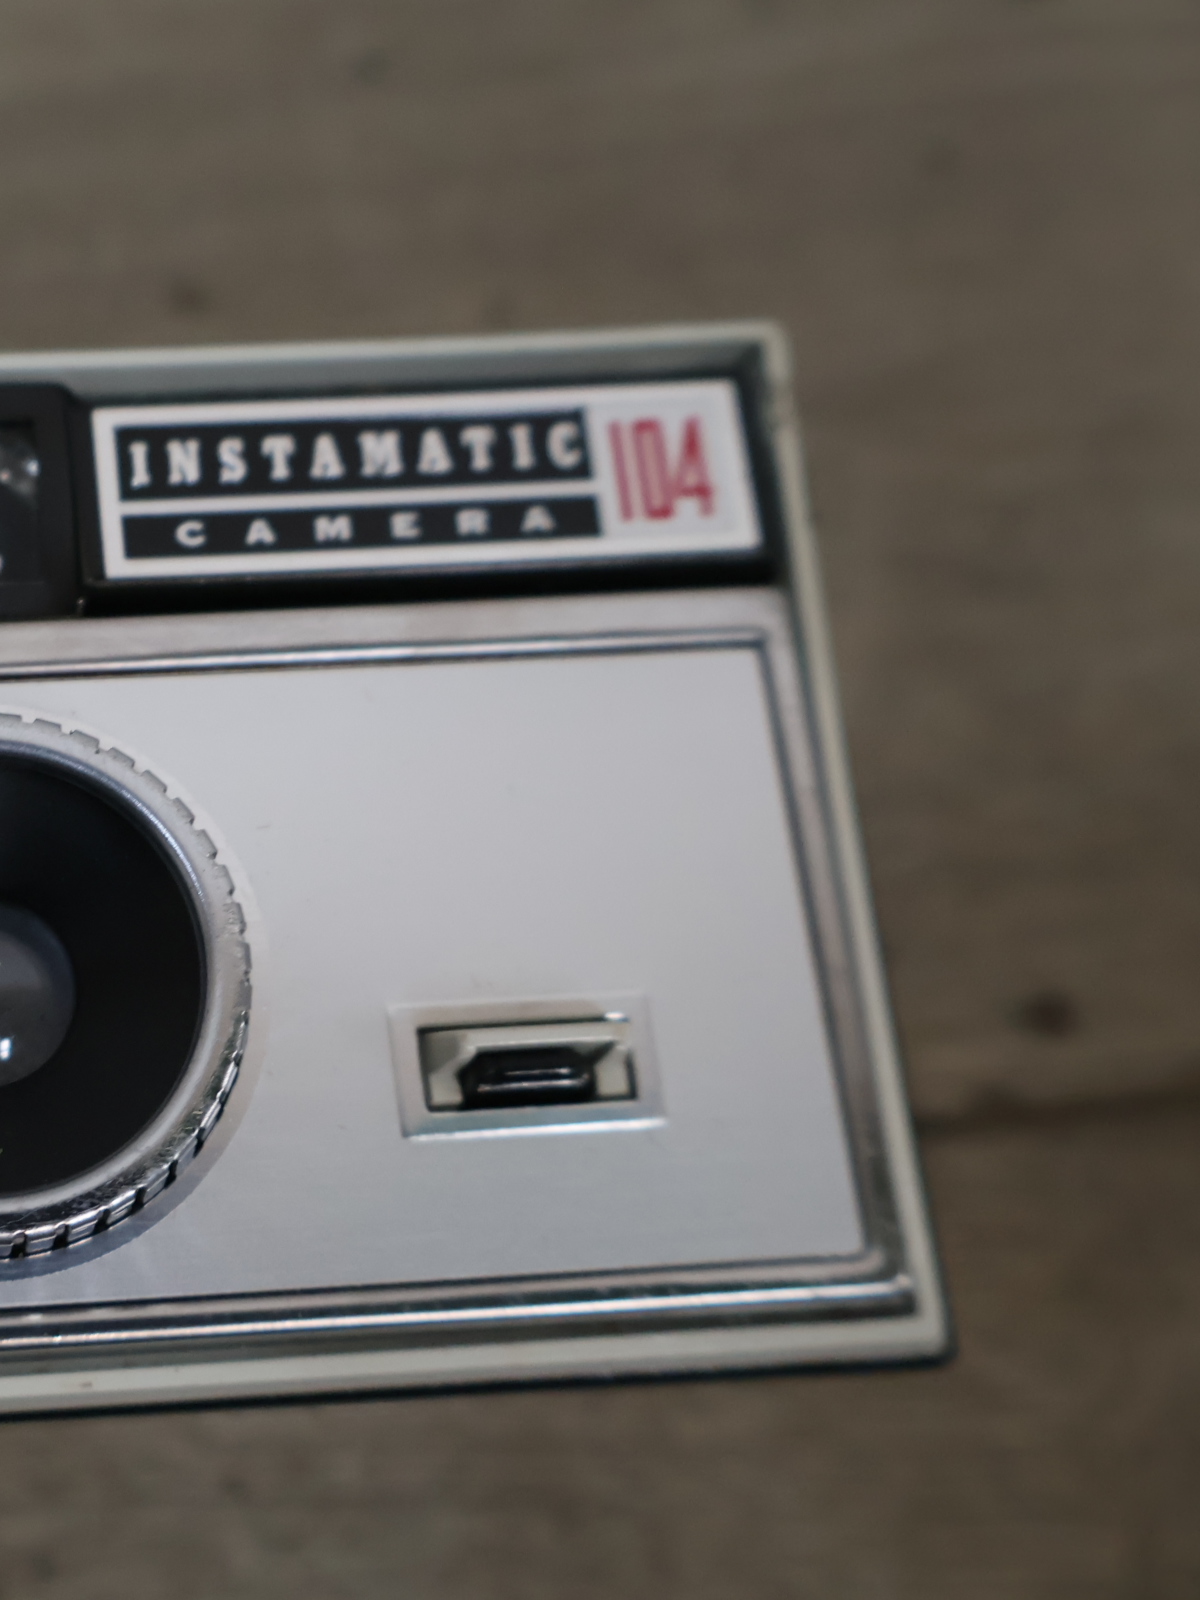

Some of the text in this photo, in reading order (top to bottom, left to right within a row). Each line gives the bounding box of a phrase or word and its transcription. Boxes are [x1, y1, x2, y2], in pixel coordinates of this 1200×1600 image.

[129, 422, 583, 488] INSTAMATIC
[607, 415, 716, 522] 104
[175, 505, 555, 547] CAMERA
